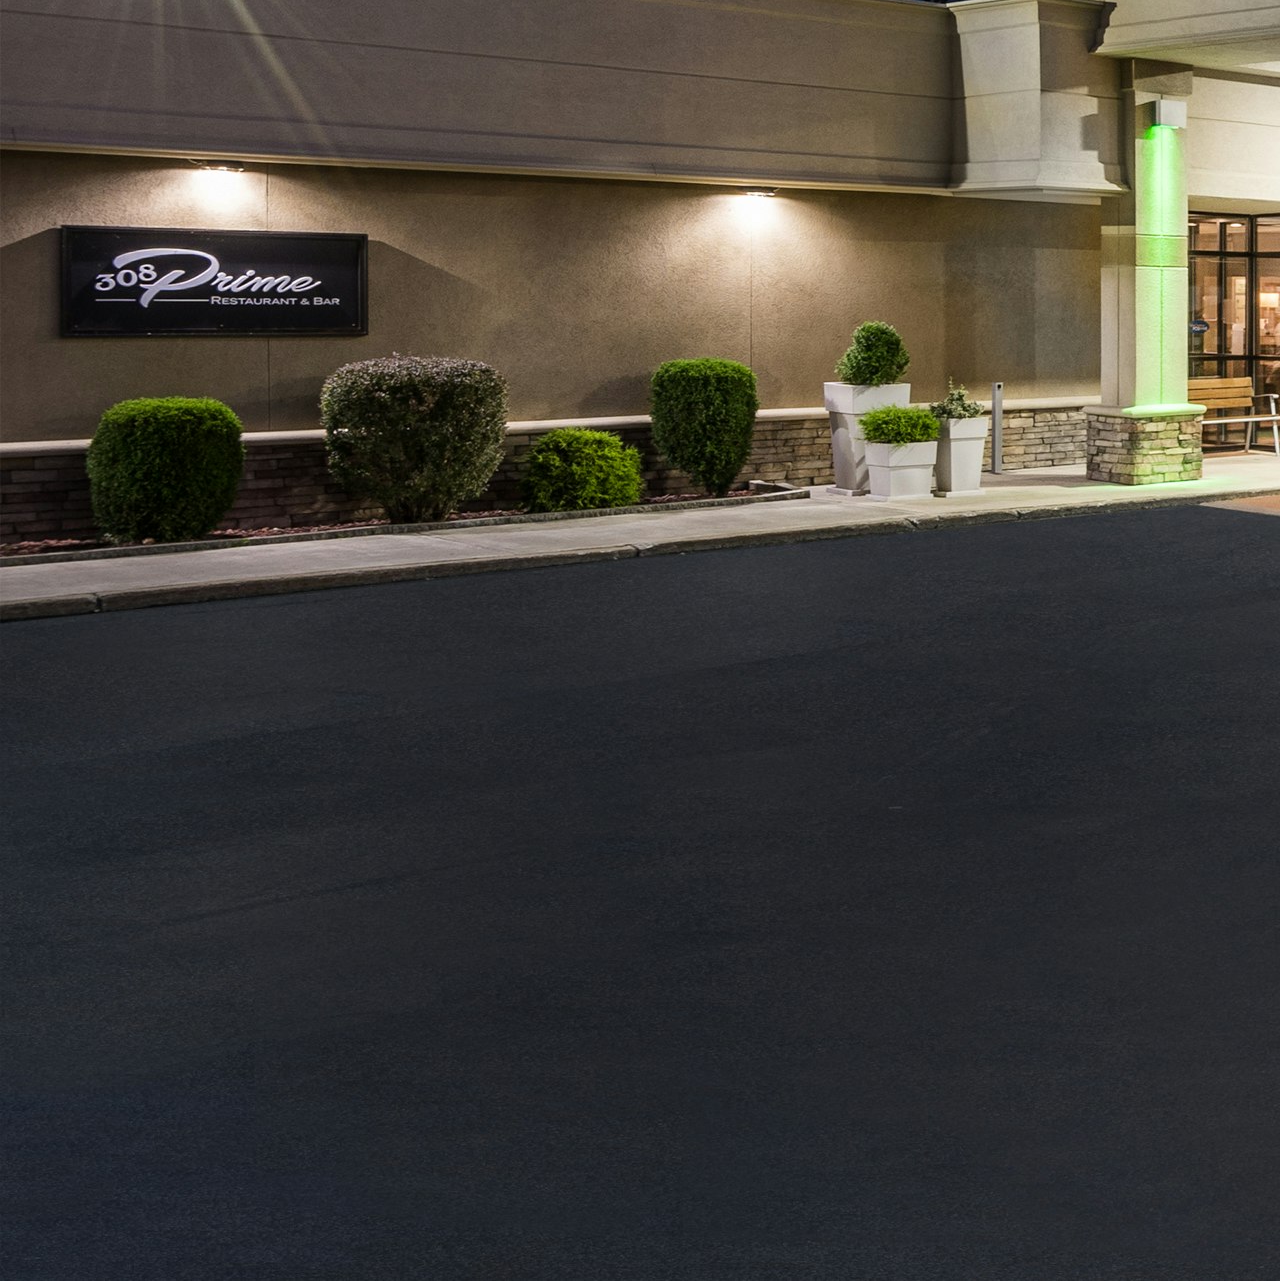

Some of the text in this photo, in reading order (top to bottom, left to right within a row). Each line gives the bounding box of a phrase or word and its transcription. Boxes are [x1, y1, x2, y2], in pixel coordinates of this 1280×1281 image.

[95, 248, 321, 309] 308 Prime
[211, 295, 340, 306] RESTAURANT & BAR
